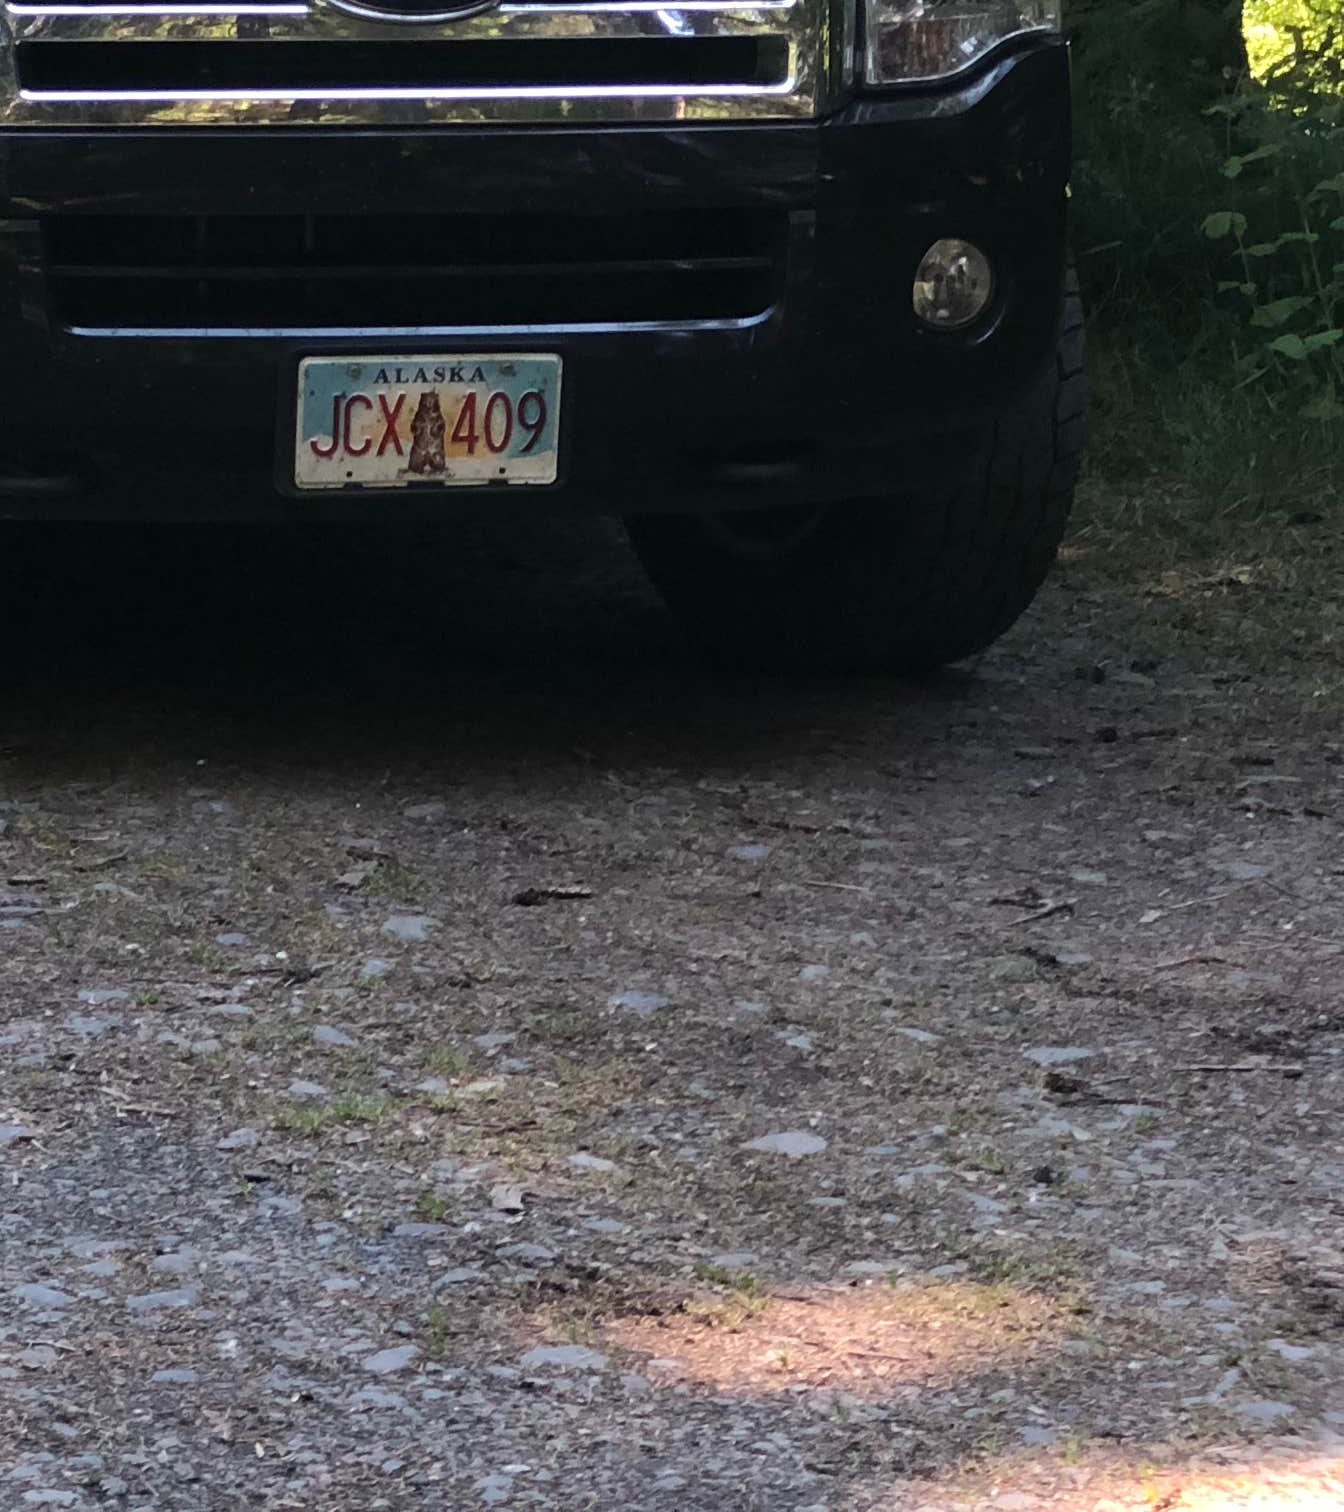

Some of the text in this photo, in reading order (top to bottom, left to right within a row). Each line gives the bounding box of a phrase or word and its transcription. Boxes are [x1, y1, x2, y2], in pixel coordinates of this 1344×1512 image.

[373, 366, 487, 385] ALASKA
[310, 390, 547, 458] JCX 409
